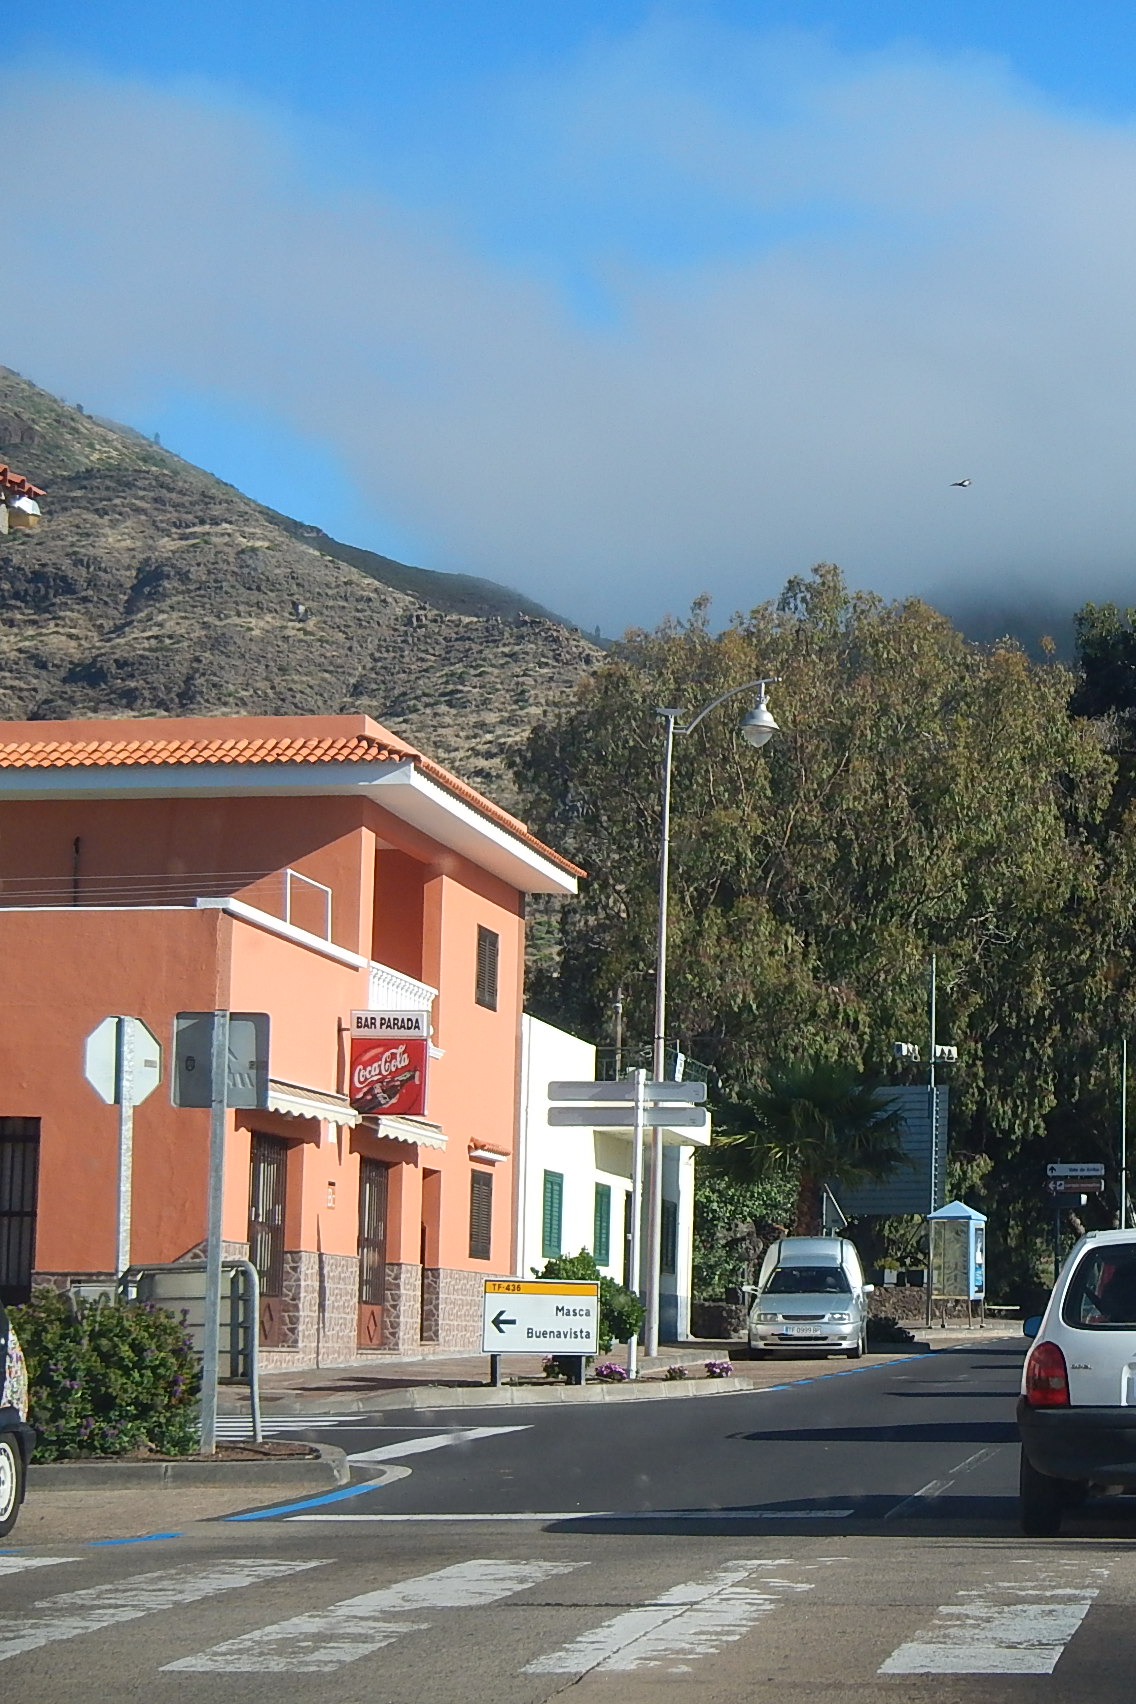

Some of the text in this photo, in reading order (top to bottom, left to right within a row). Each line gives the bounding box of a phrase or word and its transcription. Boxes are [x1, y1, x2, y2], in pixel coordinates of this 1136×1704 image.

[356, 1016, 420, 1030] BAR PARADA
[354, 1044, 410, 1088] Coca-Cola
[556, 1306, 591, 1317] Masca
[527, 1328, 591, 1339] Buenavista
